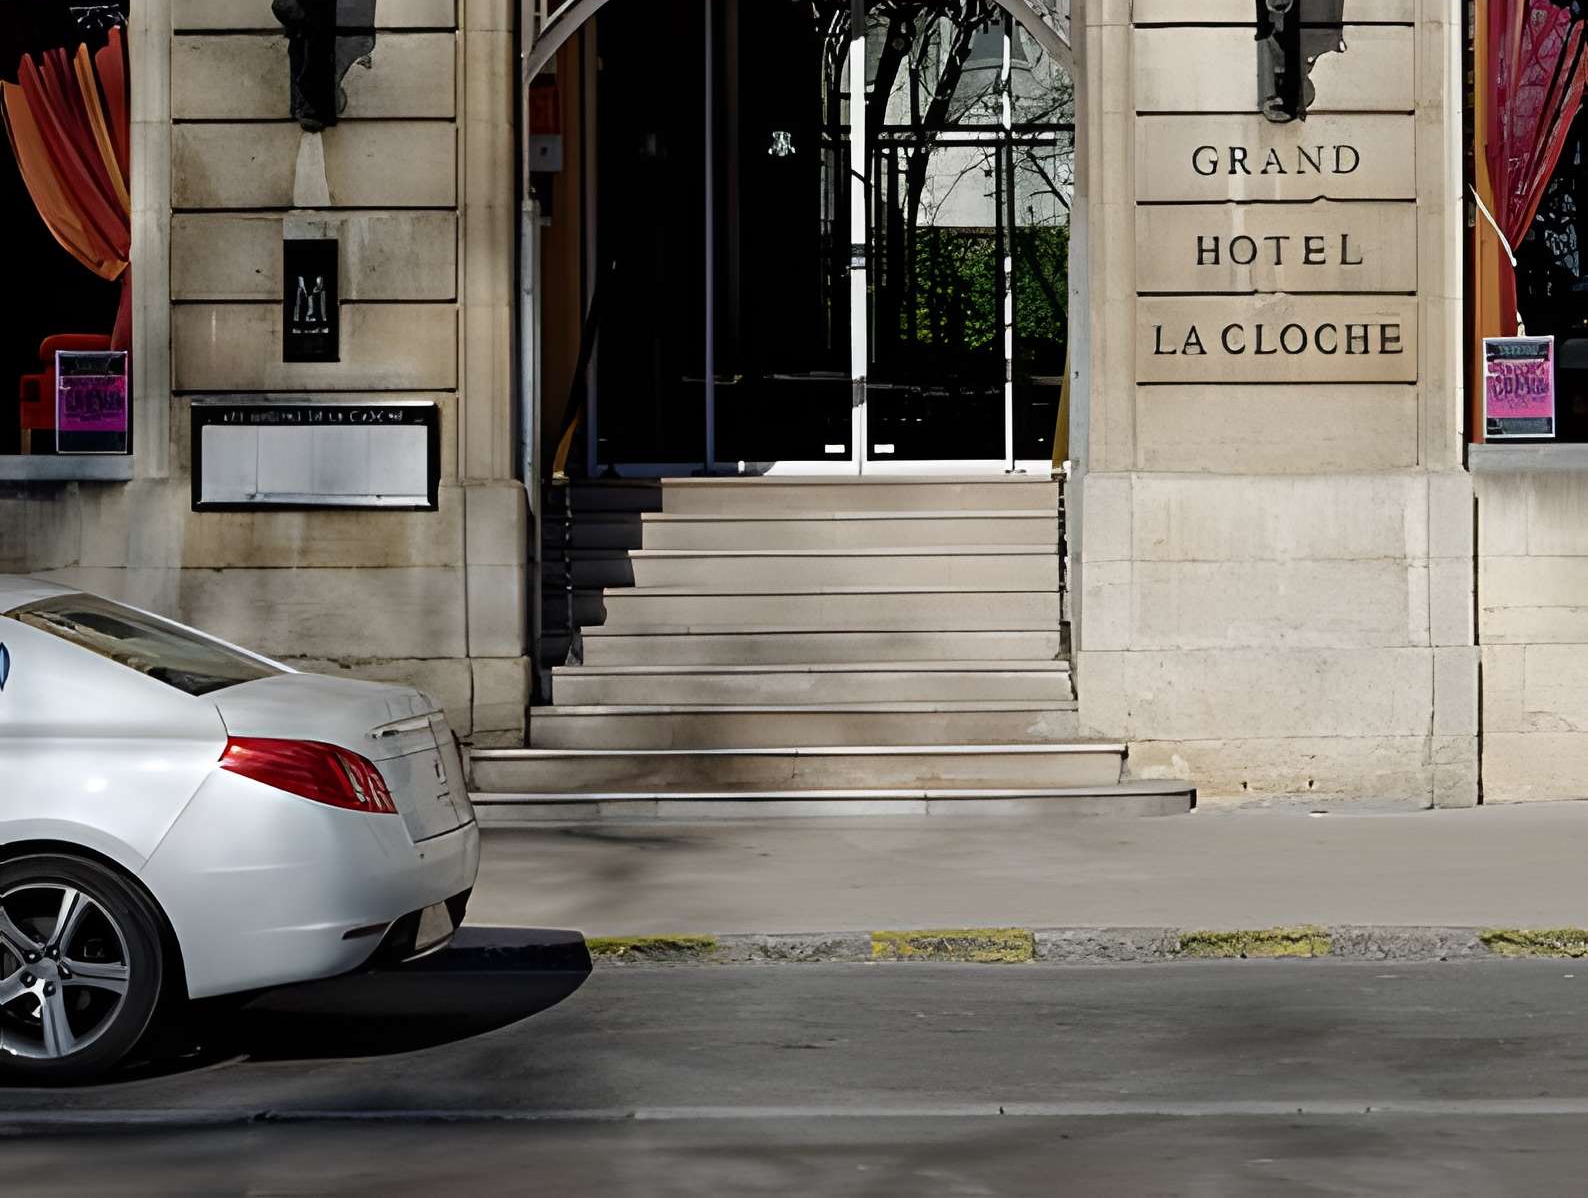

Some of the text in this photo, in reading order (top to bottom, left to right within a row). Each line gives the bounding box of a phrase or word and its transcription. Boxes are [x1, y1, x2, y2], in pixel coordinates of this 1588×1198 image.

[1192, 144, 1360, 176] GRAND
[1196, 234, 1363, 266] HOTEL
[1153, 323, 1404, 355] LA CLOCHE
